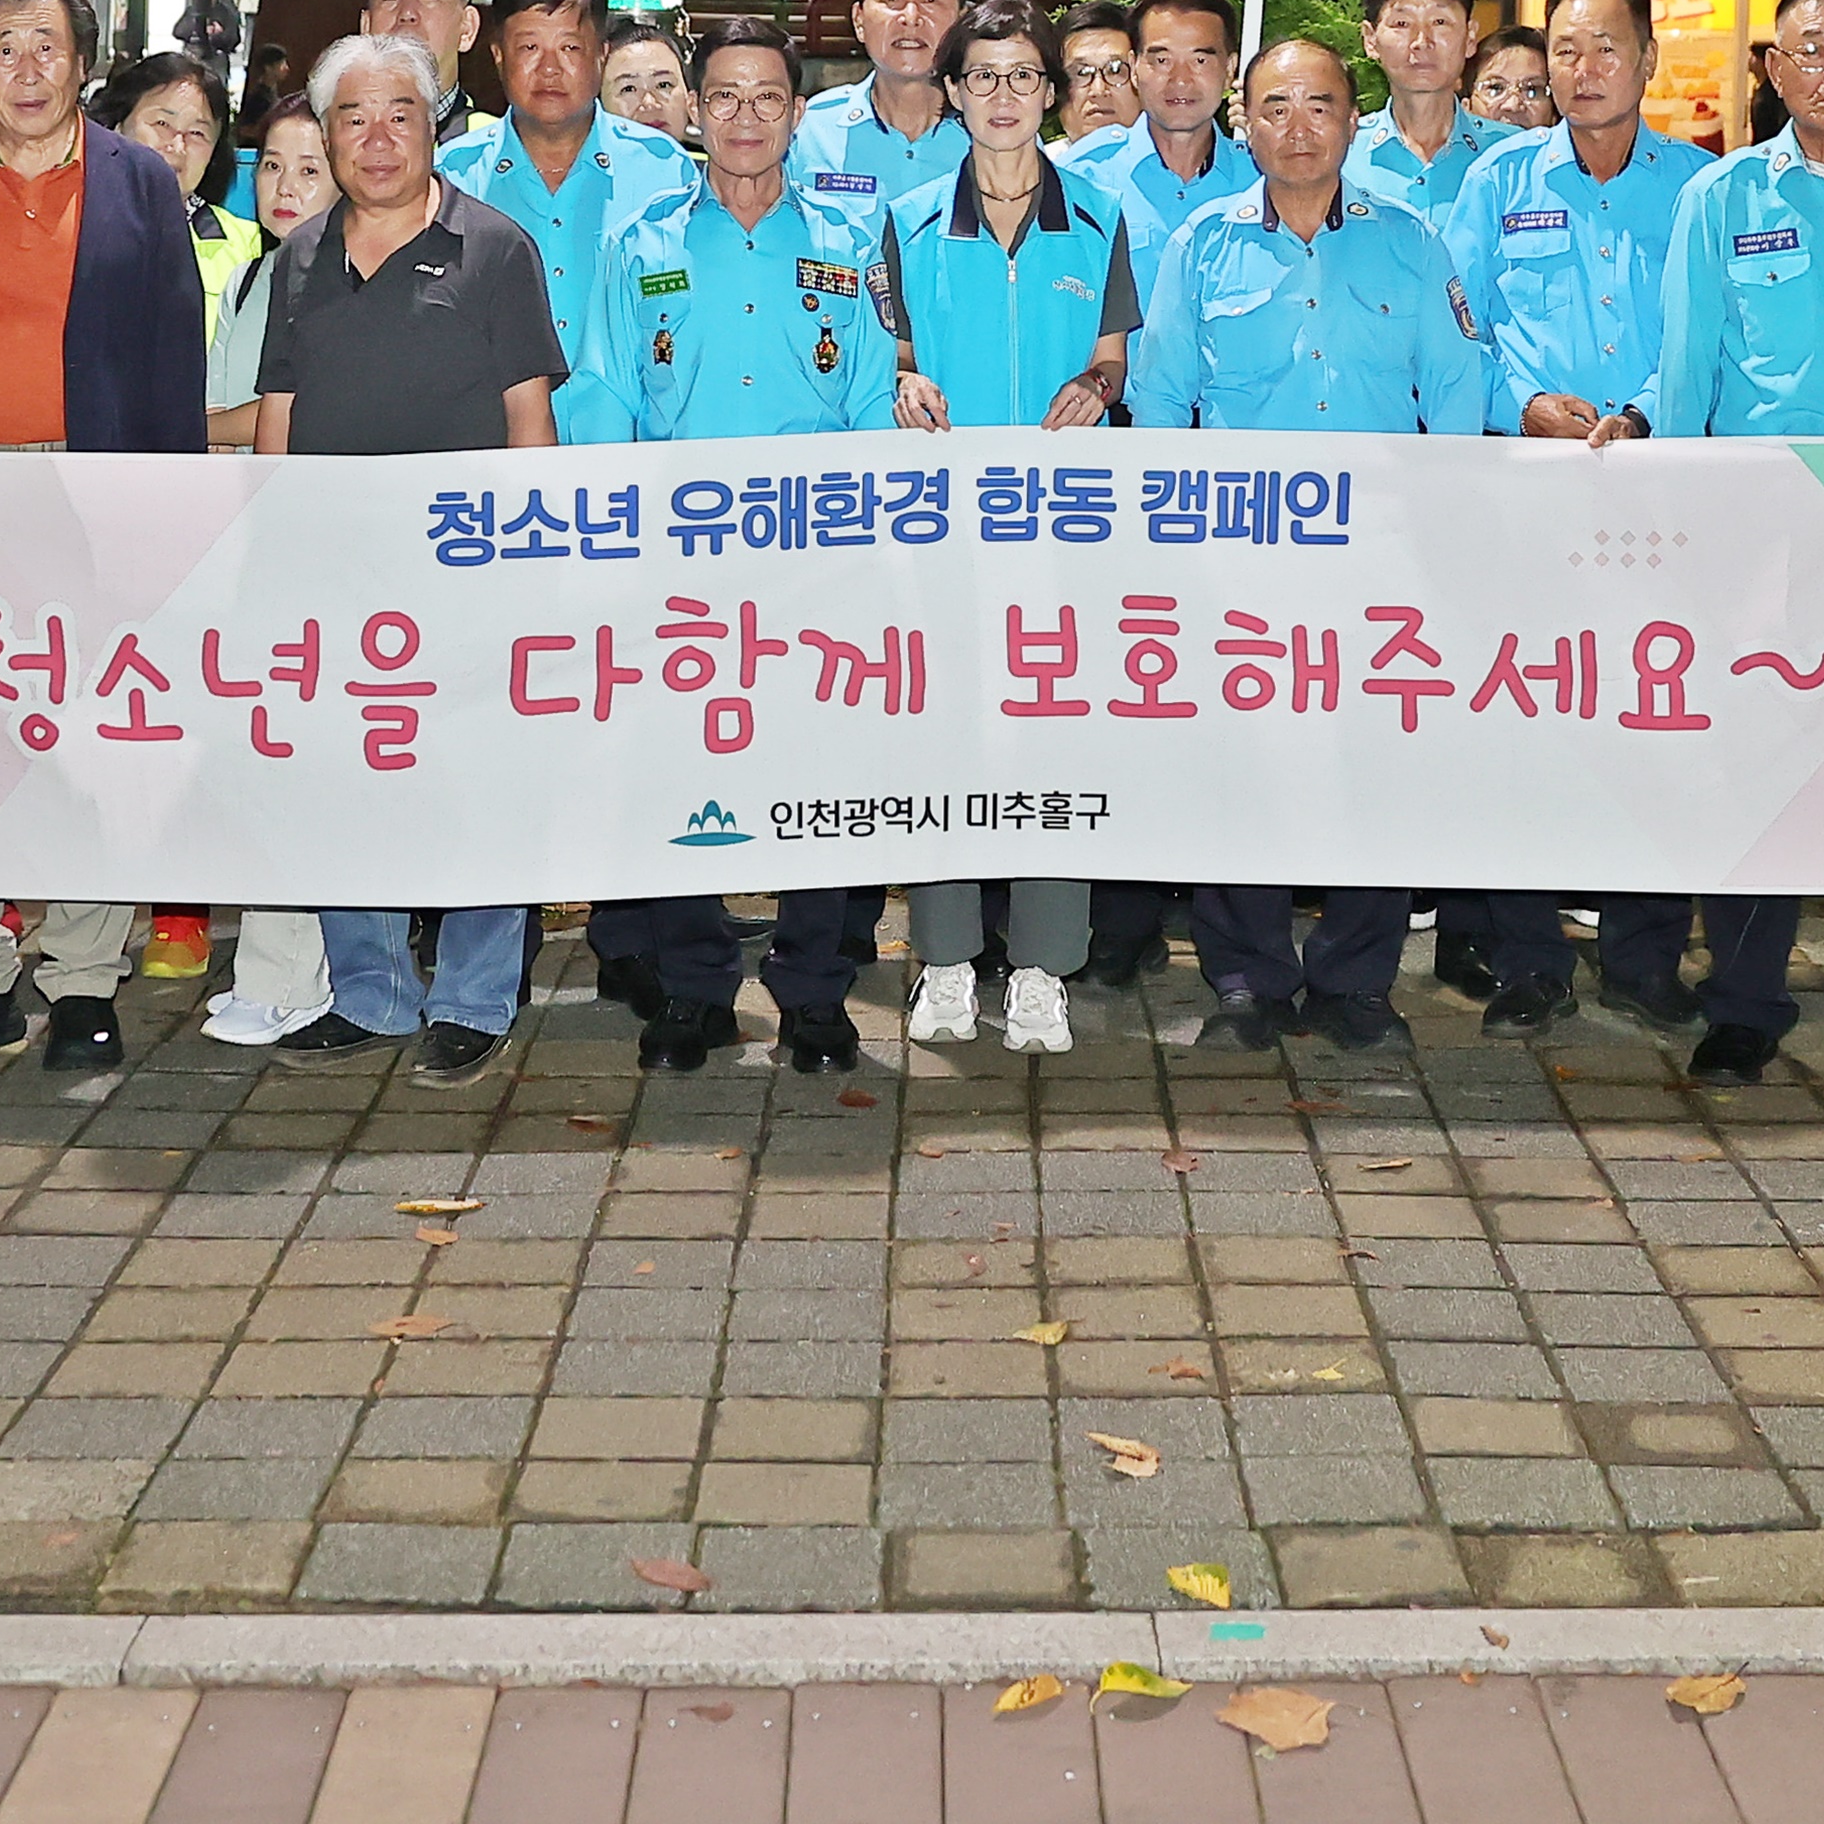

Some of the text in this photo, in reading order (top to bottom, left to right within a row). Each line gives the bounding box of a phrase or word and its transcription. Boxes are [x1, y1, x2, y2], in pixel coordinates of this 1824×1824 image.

[429, 464, 1352, 567] 청소년 유해환경 합동 캠페인
[509, 596, 926, 756] 다함께
[769, 789, 1111, 841] 인천광역시 미추홀구
